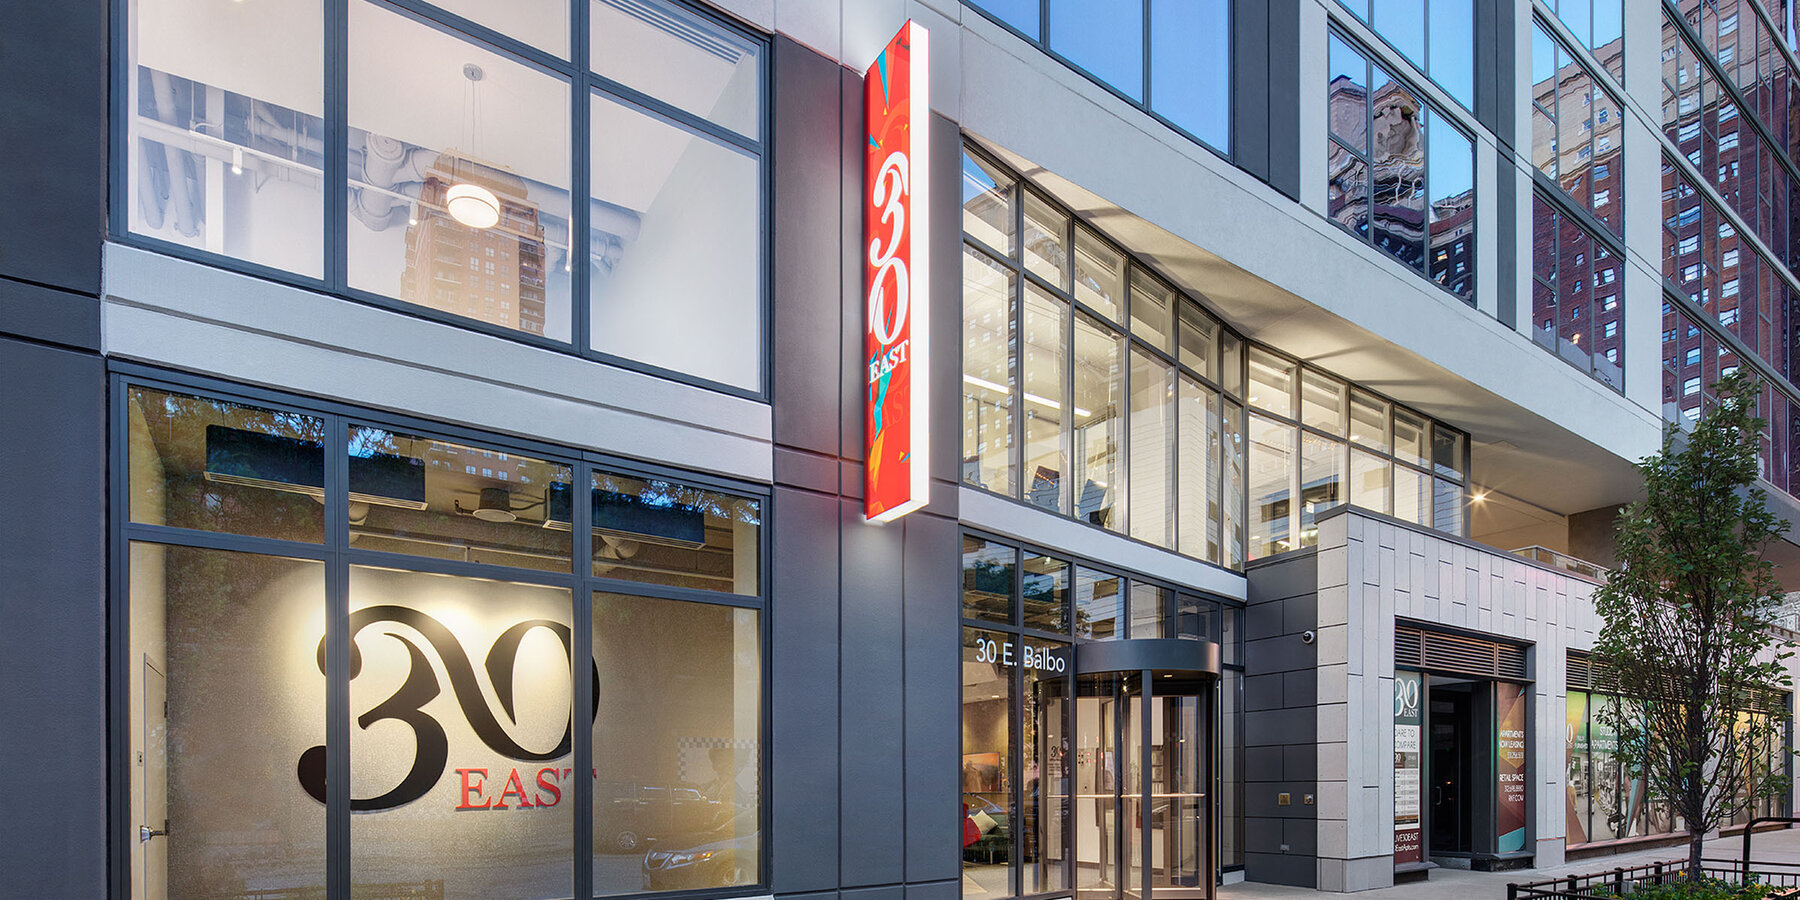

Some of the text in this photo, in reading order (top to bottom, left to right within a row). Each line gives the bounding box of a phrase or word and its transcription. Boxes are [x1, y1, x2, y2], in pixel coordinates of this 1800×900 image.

[869, 339, 909, 384] EAST
[976, 638, 1065, 673] 30 E. Balbo
[297, 605, 600, 814] 30
[1403, 708, 1419, 718] EAST
